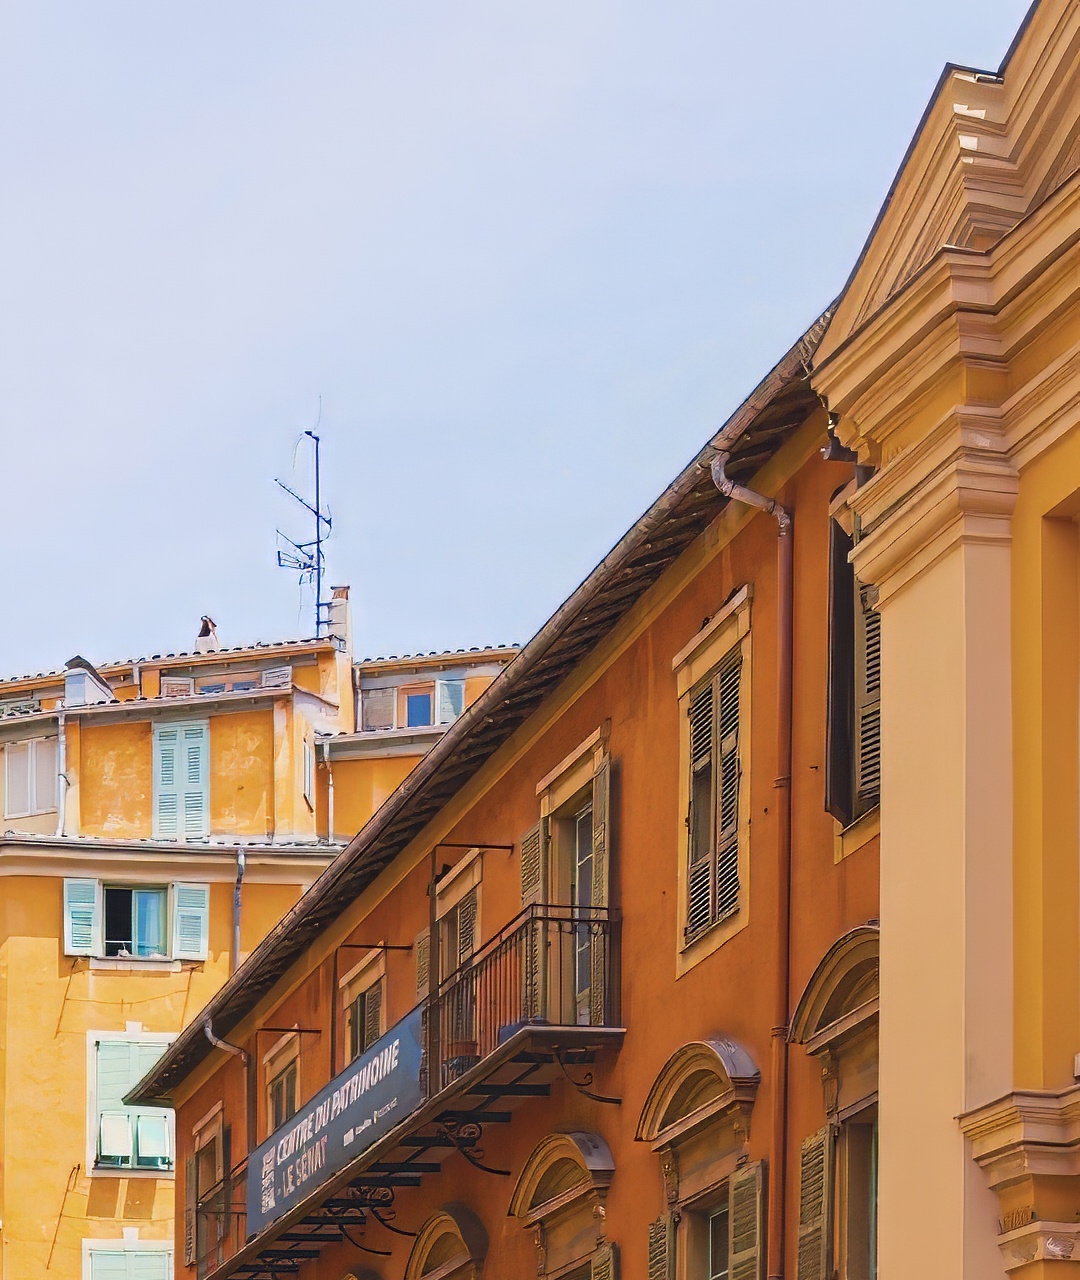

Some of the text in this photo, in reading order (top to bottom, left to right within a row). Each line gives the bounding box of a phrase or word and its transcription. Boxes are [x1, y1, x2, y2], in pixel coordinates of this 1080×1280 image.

[277, 1038, 400, 1166] CENTRE DU PATRIMOINE
[282, 1164, 296, 1198] LE
